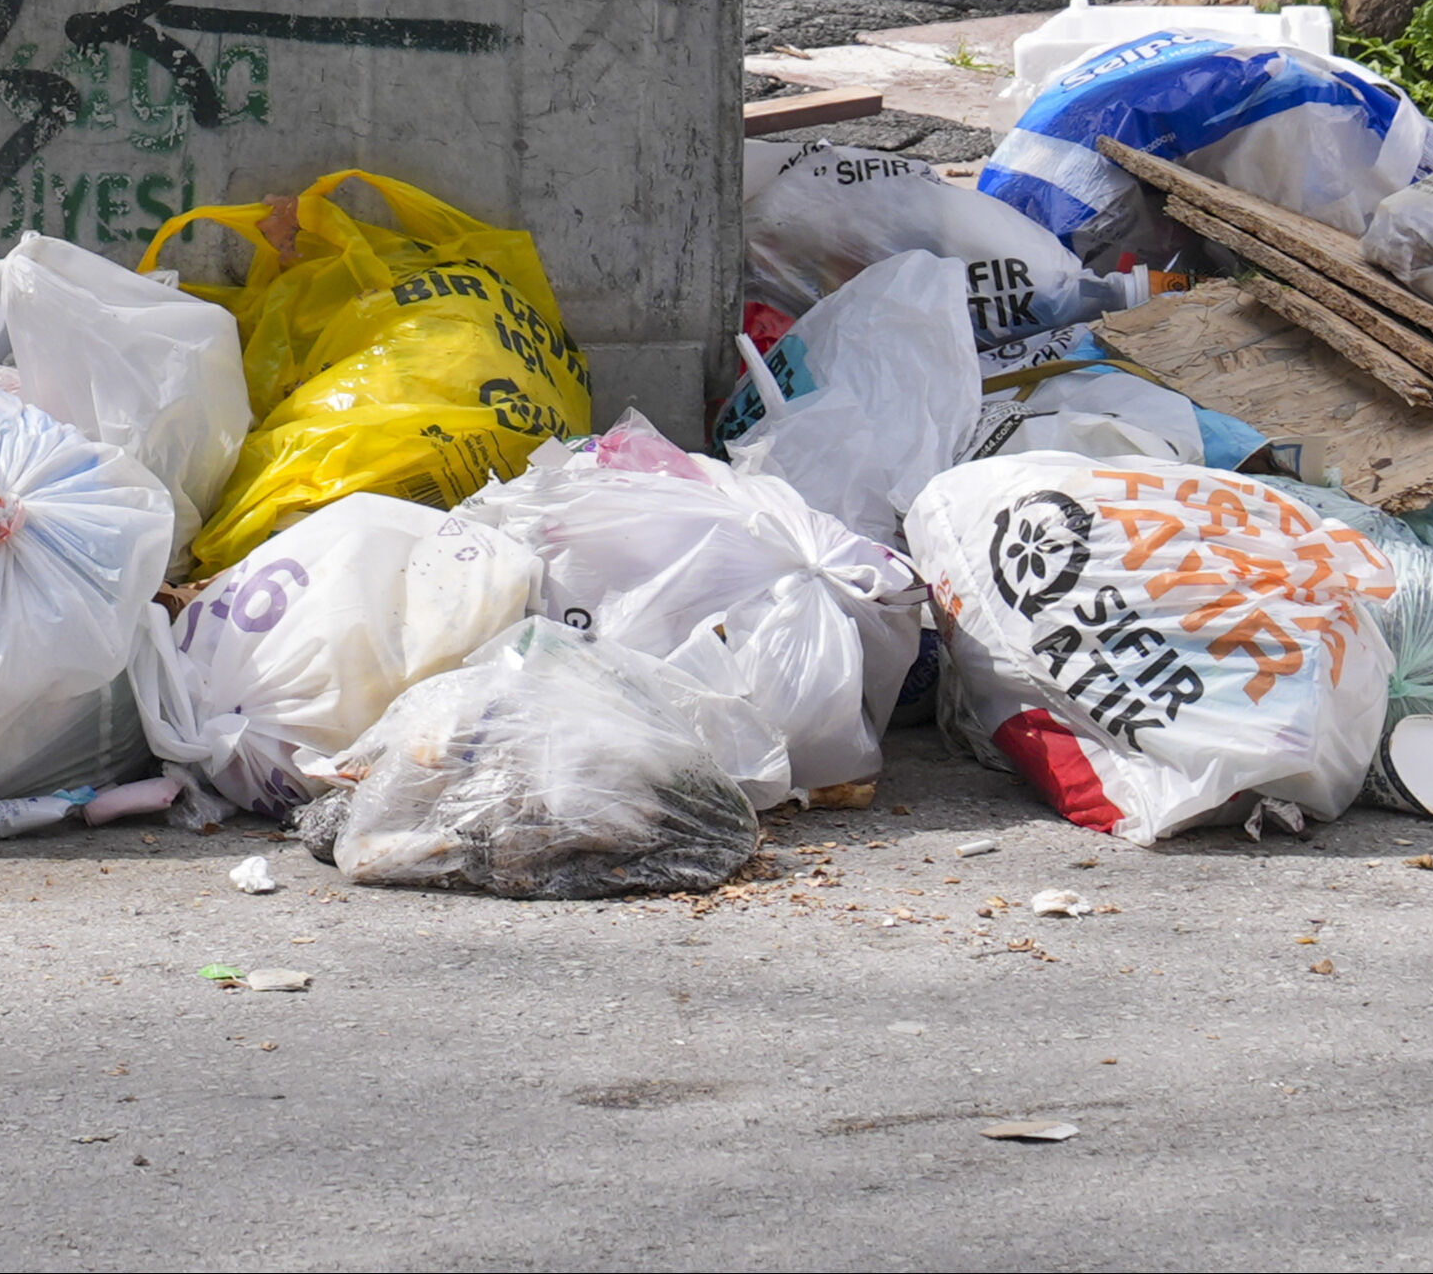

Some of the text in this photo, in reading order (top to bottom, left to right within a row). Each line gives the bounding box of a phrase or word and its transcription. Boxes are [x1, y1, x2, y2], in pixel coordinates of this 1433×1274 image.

[836, 156, 913, 186] SIFIR
[969, 256, 1035, 294] FIR
[968, 291, 1041, 331] TIK
[1073, 584, 1205, 722] SIFIR
[1030, 623, 1166, 754] ATIK
